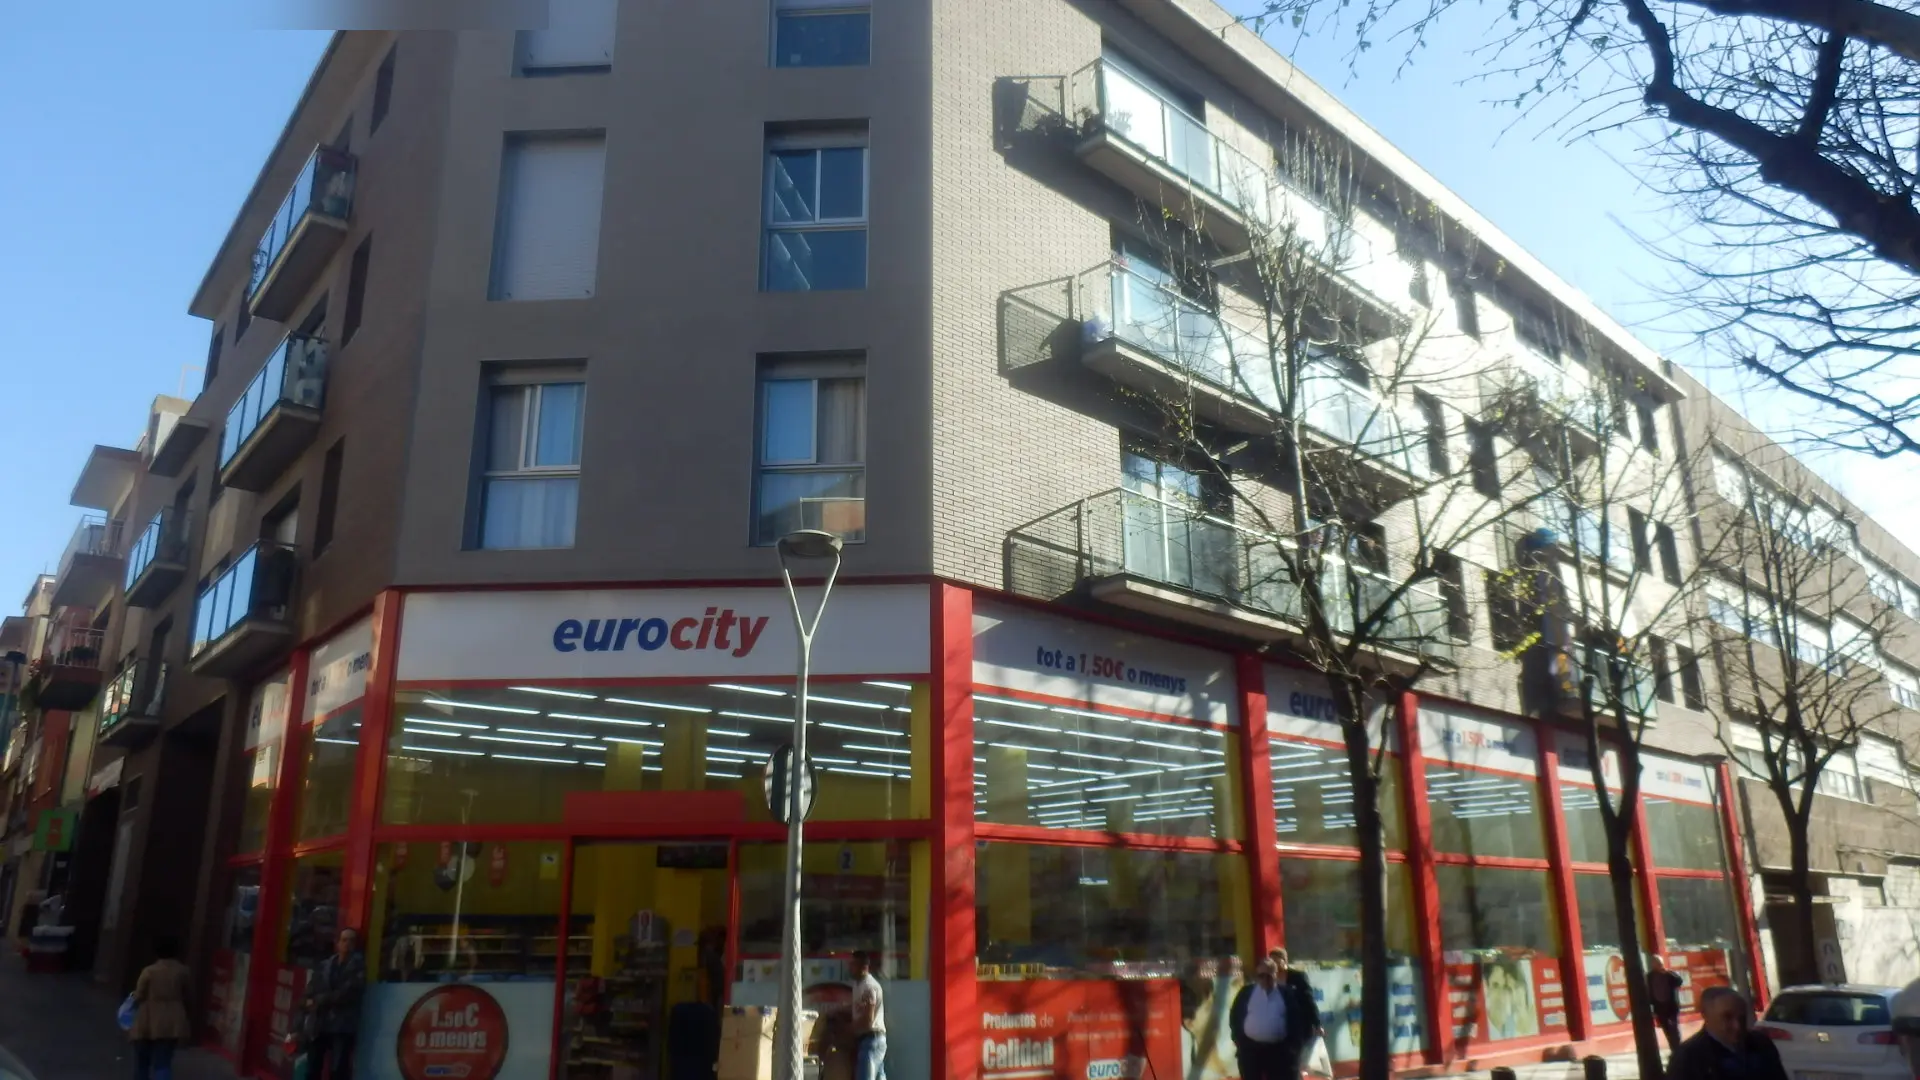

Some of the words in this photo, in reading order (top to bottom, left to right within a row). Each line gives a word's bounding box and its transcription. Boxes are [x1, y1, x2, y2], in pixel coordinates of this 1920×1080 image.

[553, 606, 769, 658] eurocity
[1036, 645, 1062, 669] tot
[1066, 655, 1075, 672] a
[1079, 653, 1125, 681] 1,50€
[1127, 667, 1137, 684] o
[1139, 669, 1187, 694] menys
[983, 1012, 1037, 1030] Productos
[1039, 1013, 1054, 1029] de
[429, 1031, 487, 1050] menys
[983, 1037, 1055, 1069] Calidad
